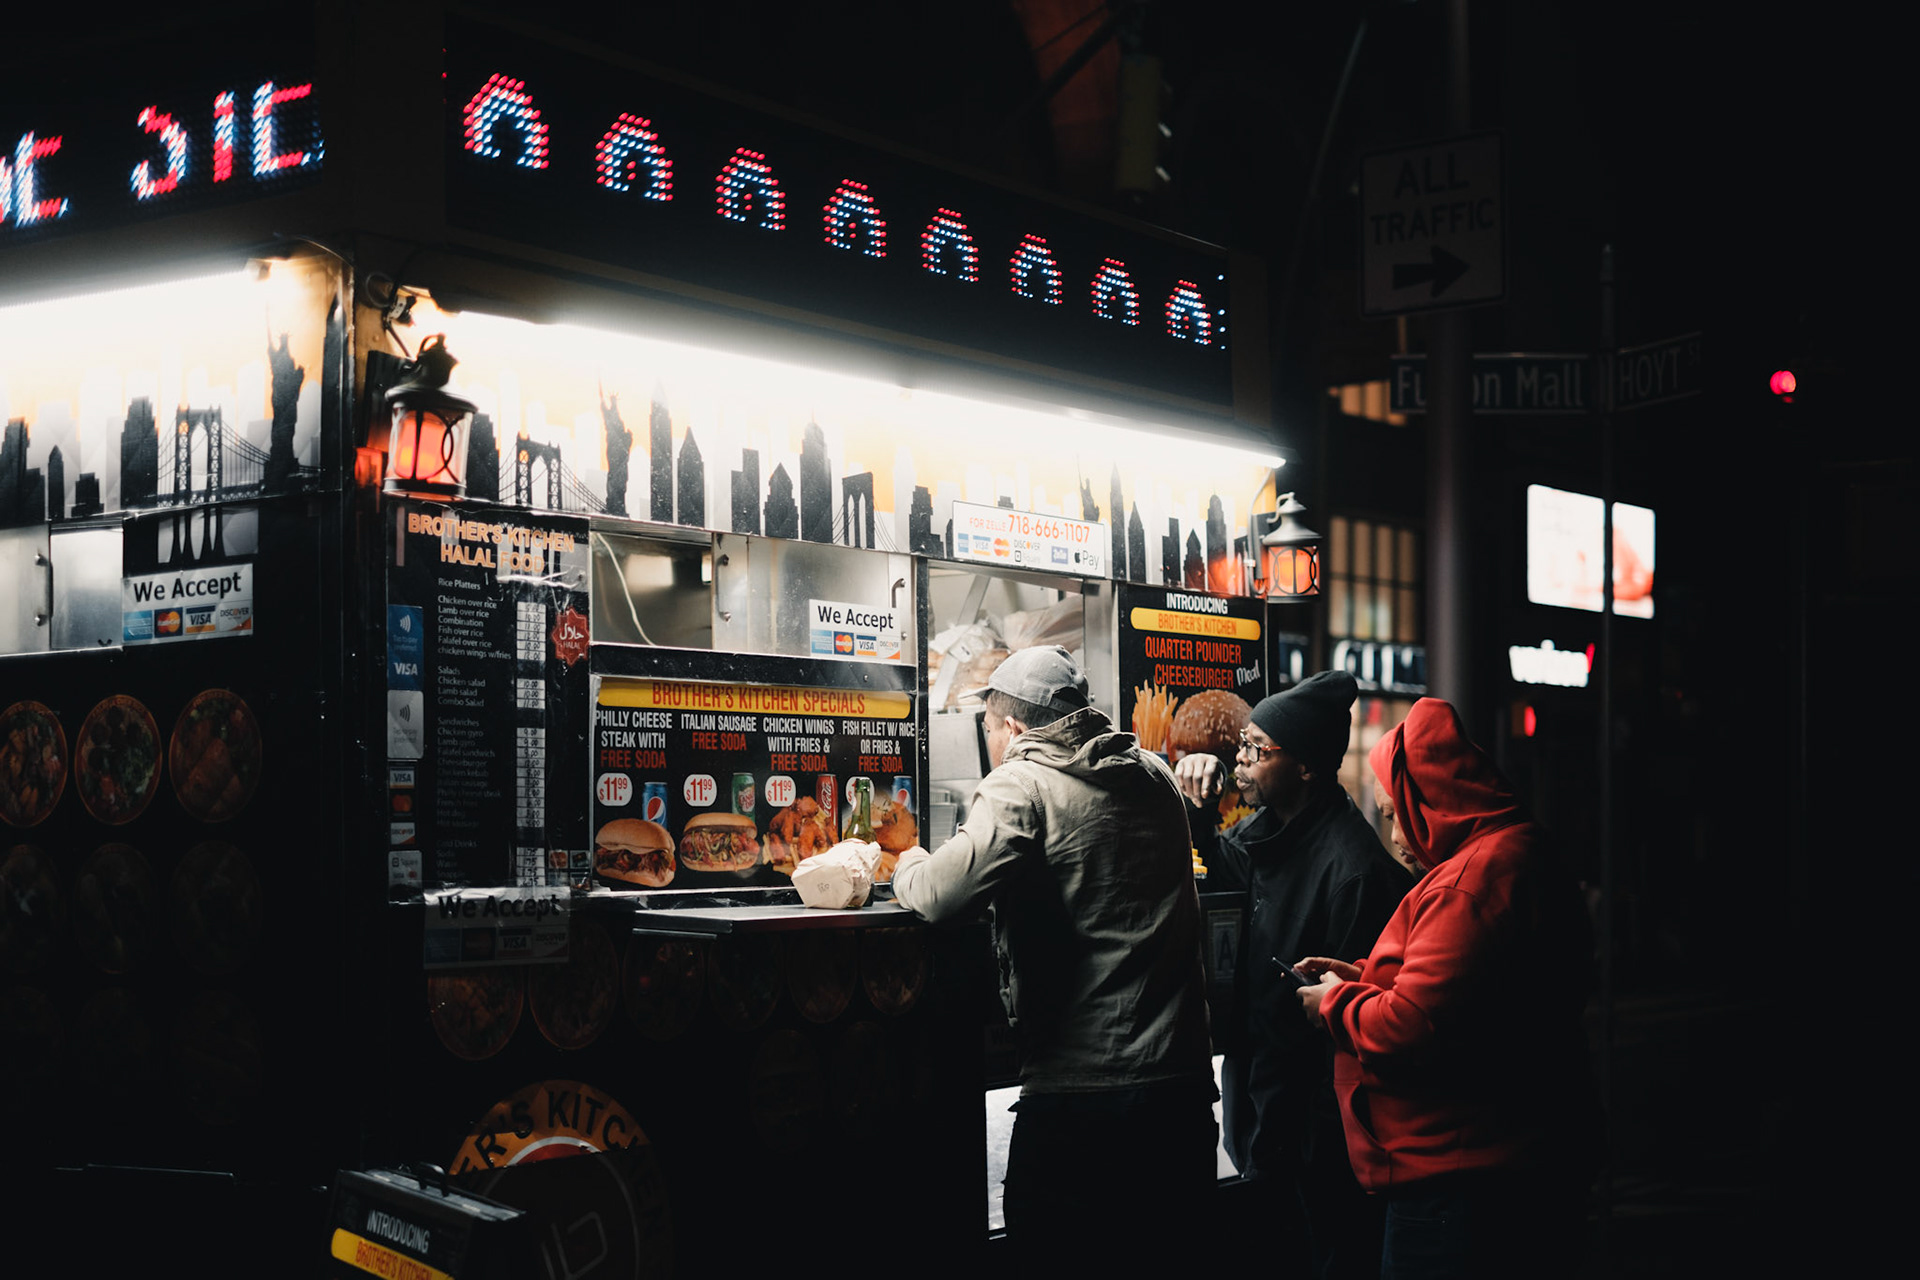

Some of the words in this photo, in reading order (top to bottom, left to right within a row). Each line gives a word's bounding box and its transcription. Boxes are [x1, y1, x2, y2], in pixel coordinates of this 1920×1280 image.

[1394, 152, 1469, 199] ALL
[1369, 197, 1495, 244] TRAFFIC
[1619, 347, 1681, 403] HOYT
[1397, 365, 1501, 407] Fun
[1516, 362, 1583, 407] Mall
[969, 518, 985, 529] FOR
[407, 512, 503, 544] BROTHER'S
[507, 526, 575, 554] KITCHEN
[440, 544, 497, 569] HALAL
[499, 551, 545, 573] FOOD
[1083, 550, 1099, 569] Pay
[133, 580, 165, 603] We
[171, 572, 241, 600] Accept
[438, 577, 453, 587] Rice
[454, 579, 481, 591] Platters
[437, 594, 467, 606] Chicken
[484, 600, 497, 609] rice
[1166, 592, 1228, 615] INTRODUCING
[190, 613, 212, 626] VISA
[438, 605, 458, 615] Lamb
[459, 609, 475, 617] over
[476, 609, 490, 618] rice
[817, 605, 841, 624] We
[845, 608, 893, 632] Accept
[438, 615, 484, 627] Combination
[1158, 612, 1202, 633] BROTHER'S
[1204, 617, 1237, 636] KITCHEN
[438, 625, 452, 634] Fish
[470, 629, 484, 638] rice
[438, 635, 461, 645] Falafel
[462, 639, 478, 647] over
[479, 640, 492, 648] rice
[563, 642, 581, 650] HALAL
[857, 641, 873, 650] VISA
[1145, 635, 1193, 661] QUARTER
[1195, 640, 1242, 665] POUNDER
[466, 649, 487, 659] wings
[394, 662, 418, 676] VISA
[437, 665, 461, 676] Salads
[1154, 663, 1234, 689] CHEESEBURGER
[1236, 658, 1261, 687] Meal
[437, 676, 466, 686] Chicken
[467, 678, 486, 688] salad
[437, 687, 458, 696] Lamb
[459, 688, 478, 697] salad
[652, 682, 734, 709] BROTHER'S
[739, 686, 799, 712] KITCHEN
[803, 690, 865, 714] SPECIALS
[437, 696, 465, 706] Combo
[465, 698, 485, 707] Salad
[437, 716, 480, 727] Sandwiches
[595, 710, 629, 728] PHILLY
[632, 711, 673, 729] CHEESE
[681, 713, 716, 731] ITALIAN
[717, 715, 757, 732] SAUSAGE
[763, 716, 803, 734] CHICKEN
[804, 718, 835, 735] WINGS
[842, 720, 860, 736] FISH
[861, 721, 886, 737] FILLET
[887, 722, 898, 737] W/
[899, 722, 915, 737] RICE
[467, 730, 484, 739] gyro
[601, 730, 636, 748] STEAK
[638, 732, 666, 749] WITH
[692, 732, 718, 750] FREE
[720, 733, 747, 751] SODA
[767, 736, 793, 752] WITH
[794, 737, 821, 753] FRIES
[823, 738, 831, 753] &
[860, 739, 871, 754] OR
[872, 740, 893, 755] FRIES
[894, 740, 901, 755] &
[600, 750, 632, 769] FREE
[635, 750, 667, 769] SODA
[770, 754, 798, 771] FREE
[800, 755, 828, 772] SODA
[858, 755, 879, 772] FREE
[881, 756, 904, 773] SODA
[393, 772, 412, 783] VISA
[438, 895, 477, 920] We
[482, 894, 561, 921] Accept
[502, 936, 527, 949] VISA
[367, 1208, 431, 1255] INTRODUCING
[355, 1240, 398, 1279] BROTHER'S
